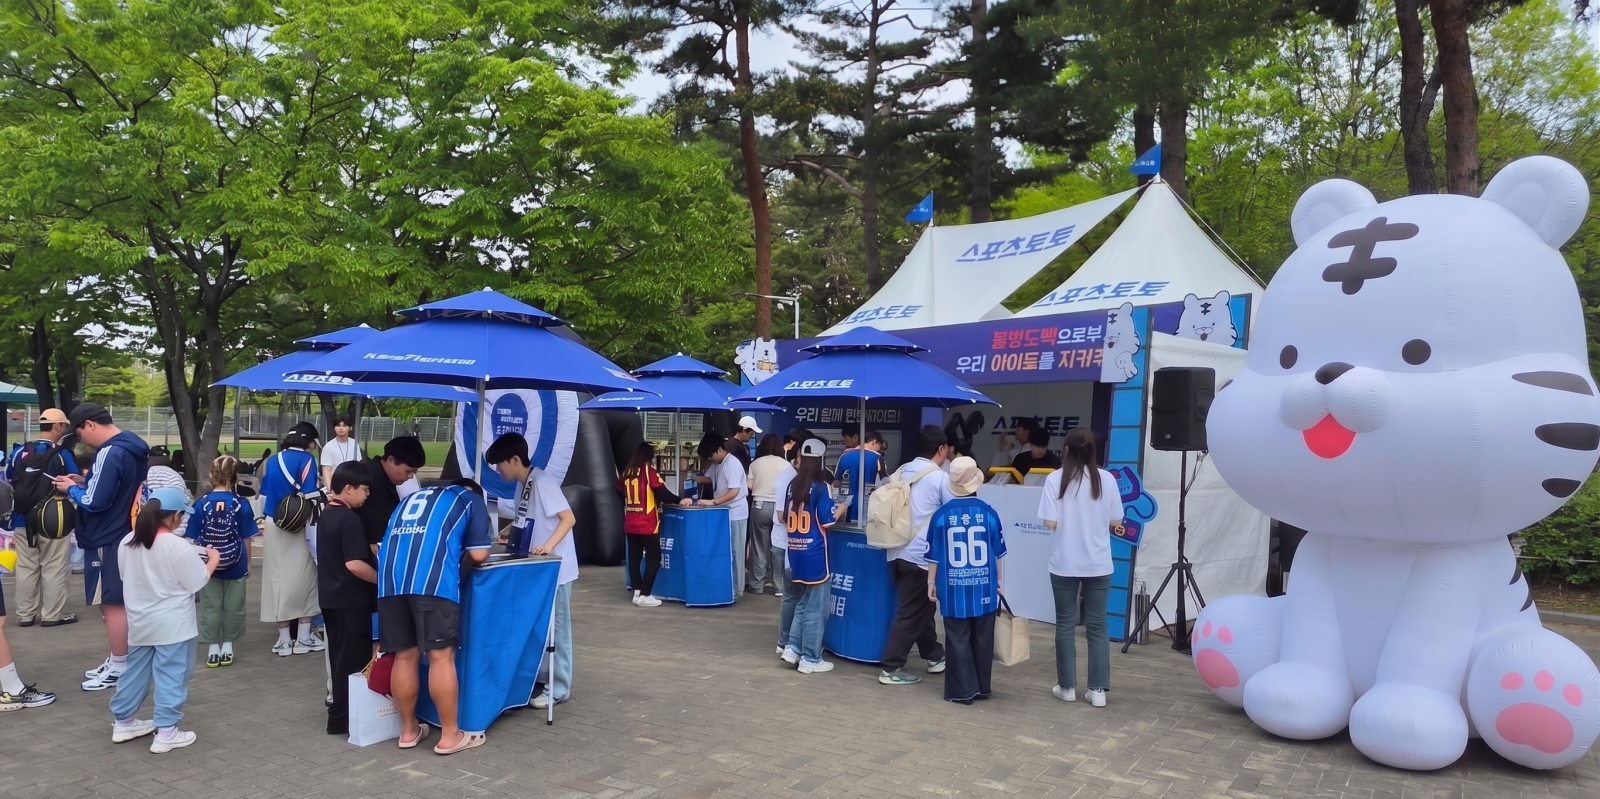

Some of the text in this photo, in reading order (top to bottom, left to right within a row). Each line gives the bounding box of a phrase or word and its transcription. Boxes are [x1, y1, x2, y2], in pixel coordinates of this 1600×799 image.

[956, 224, 1076, 262] 스포츠토토
[1031, 282, 1170, 308] 스포츠토토
[956, 354, 987, 374] 우리
[795, 407, 819, 423] 우리
[401, 489, 435, 521] 6
[624, 477, 641, 505] 11
[787, 500, 811, 534] 66
[947, 525, 988, 568] 66
